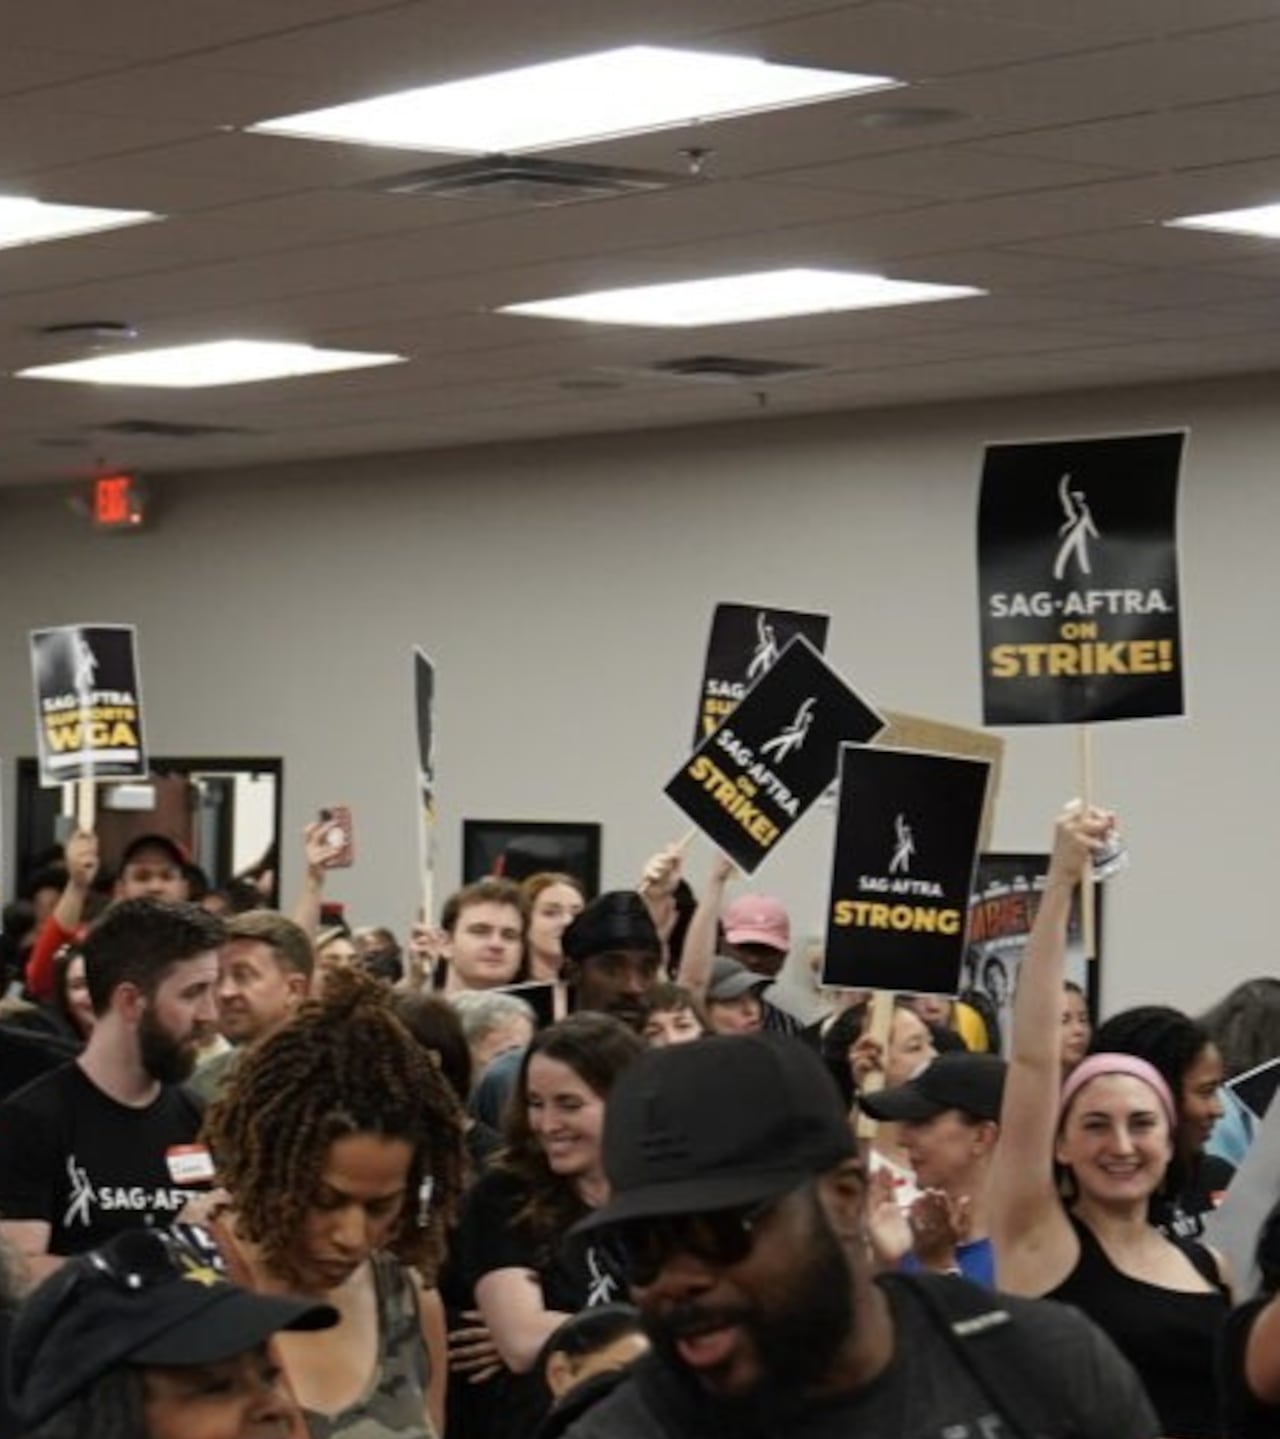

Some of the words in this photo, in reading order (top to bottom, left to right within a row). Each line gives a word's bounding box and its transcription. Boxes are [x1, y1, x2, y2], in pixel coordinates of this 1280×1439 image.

[991, 588, 1169, 617] SAG·AFTRA
[1060, 621, 1098, 640] ON
[992, 640, 1173, 677] STRIKE!
[48, 719, 139, 752] WGA
[716, 728, 801, 818] SAG·AFTRA
[688, 755, 780, 848] STRIKE!
[858, 875, 942, 896] SAG·AFTRA
[833, 899, 961, 935] STRONG
